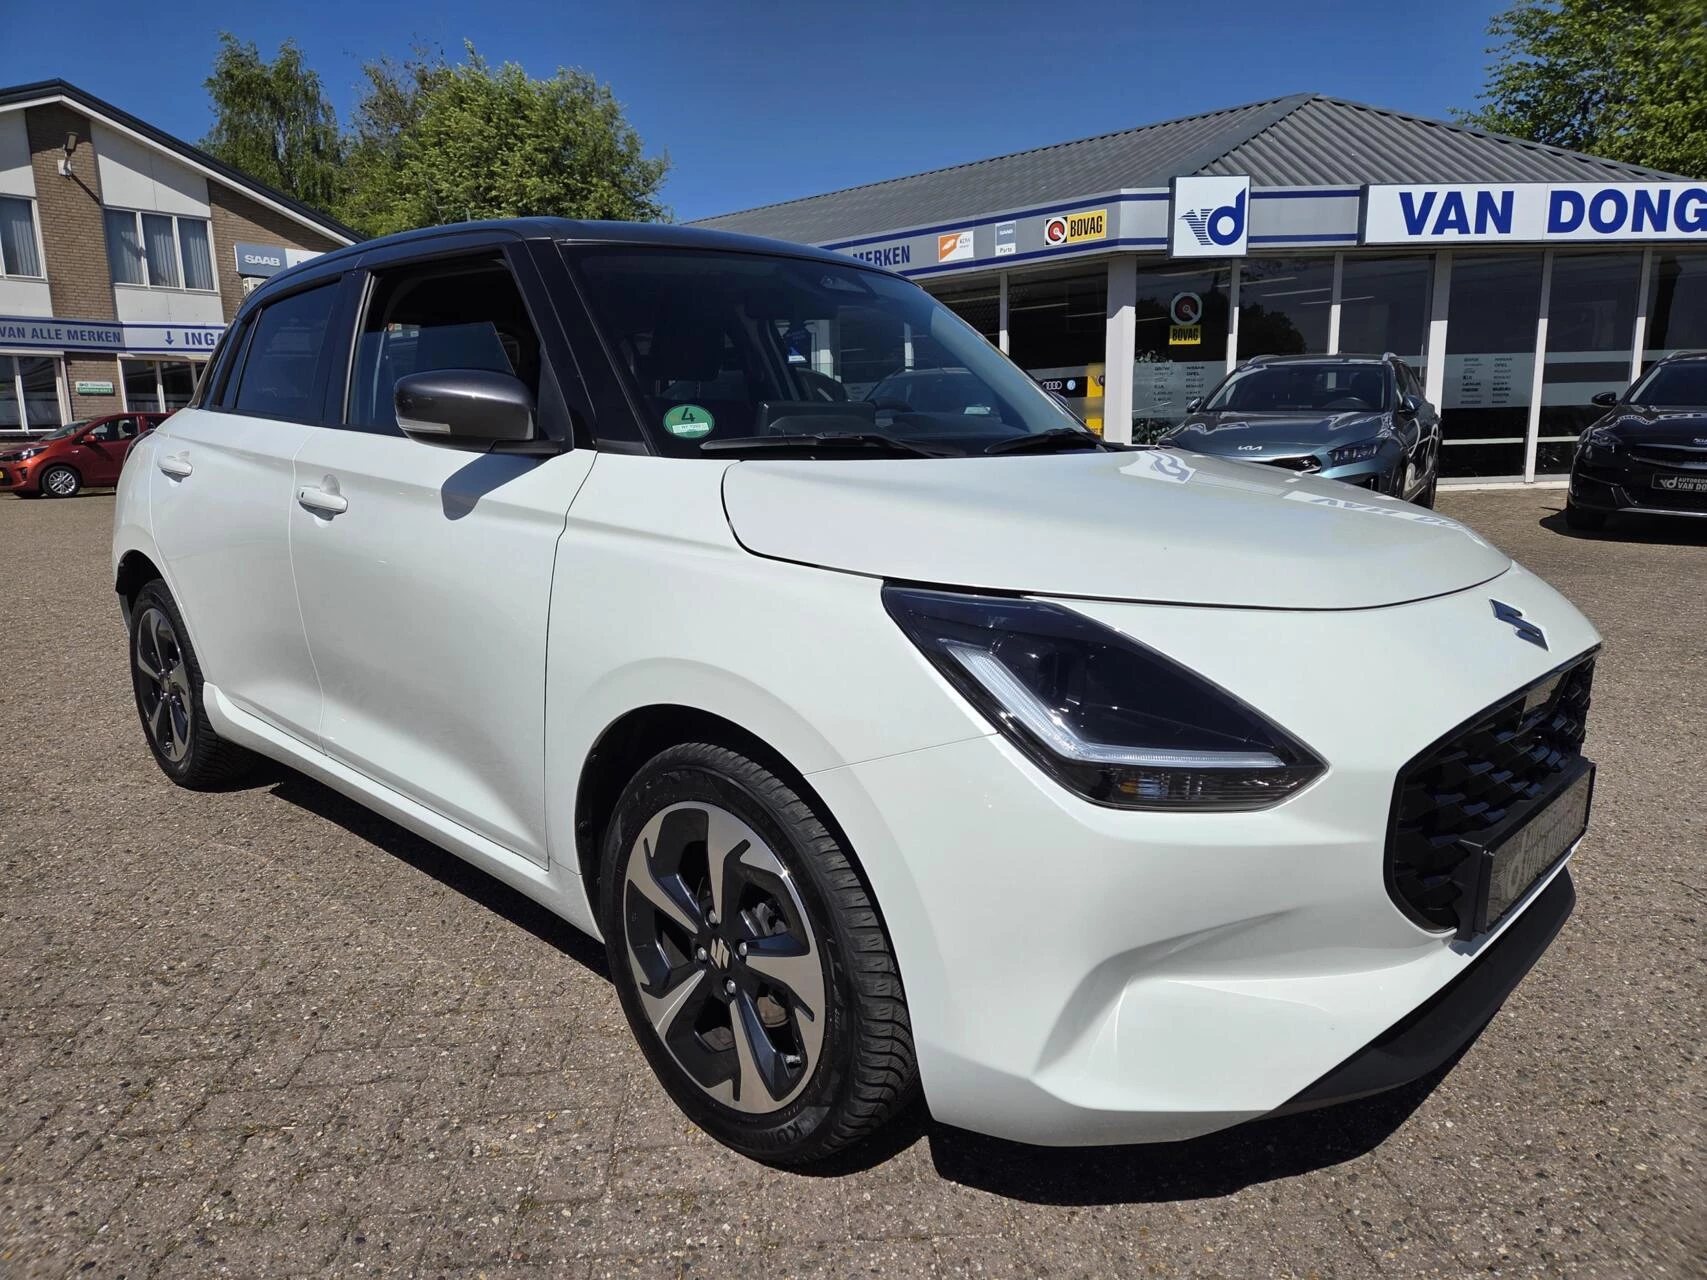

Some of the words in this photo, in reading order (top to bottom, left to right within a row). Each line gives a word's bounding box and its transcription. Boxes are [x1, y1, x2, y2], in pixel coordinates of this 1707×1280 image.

[1399, 191, 1514, 235] VAN
[1547, 188, 1707, 234] DONG
[1070, 215, 1103, 237] BOVAG
[244, 254, 280, 266] SAAB
[31, 328, 62, 340] ALLE
[66, 329, 120, 343] MERKEN
[1172, 327, 1200, 342] BOVAG
[681, 407, 696, 422] 4
[1678, 482, 1694, 490] VAN
